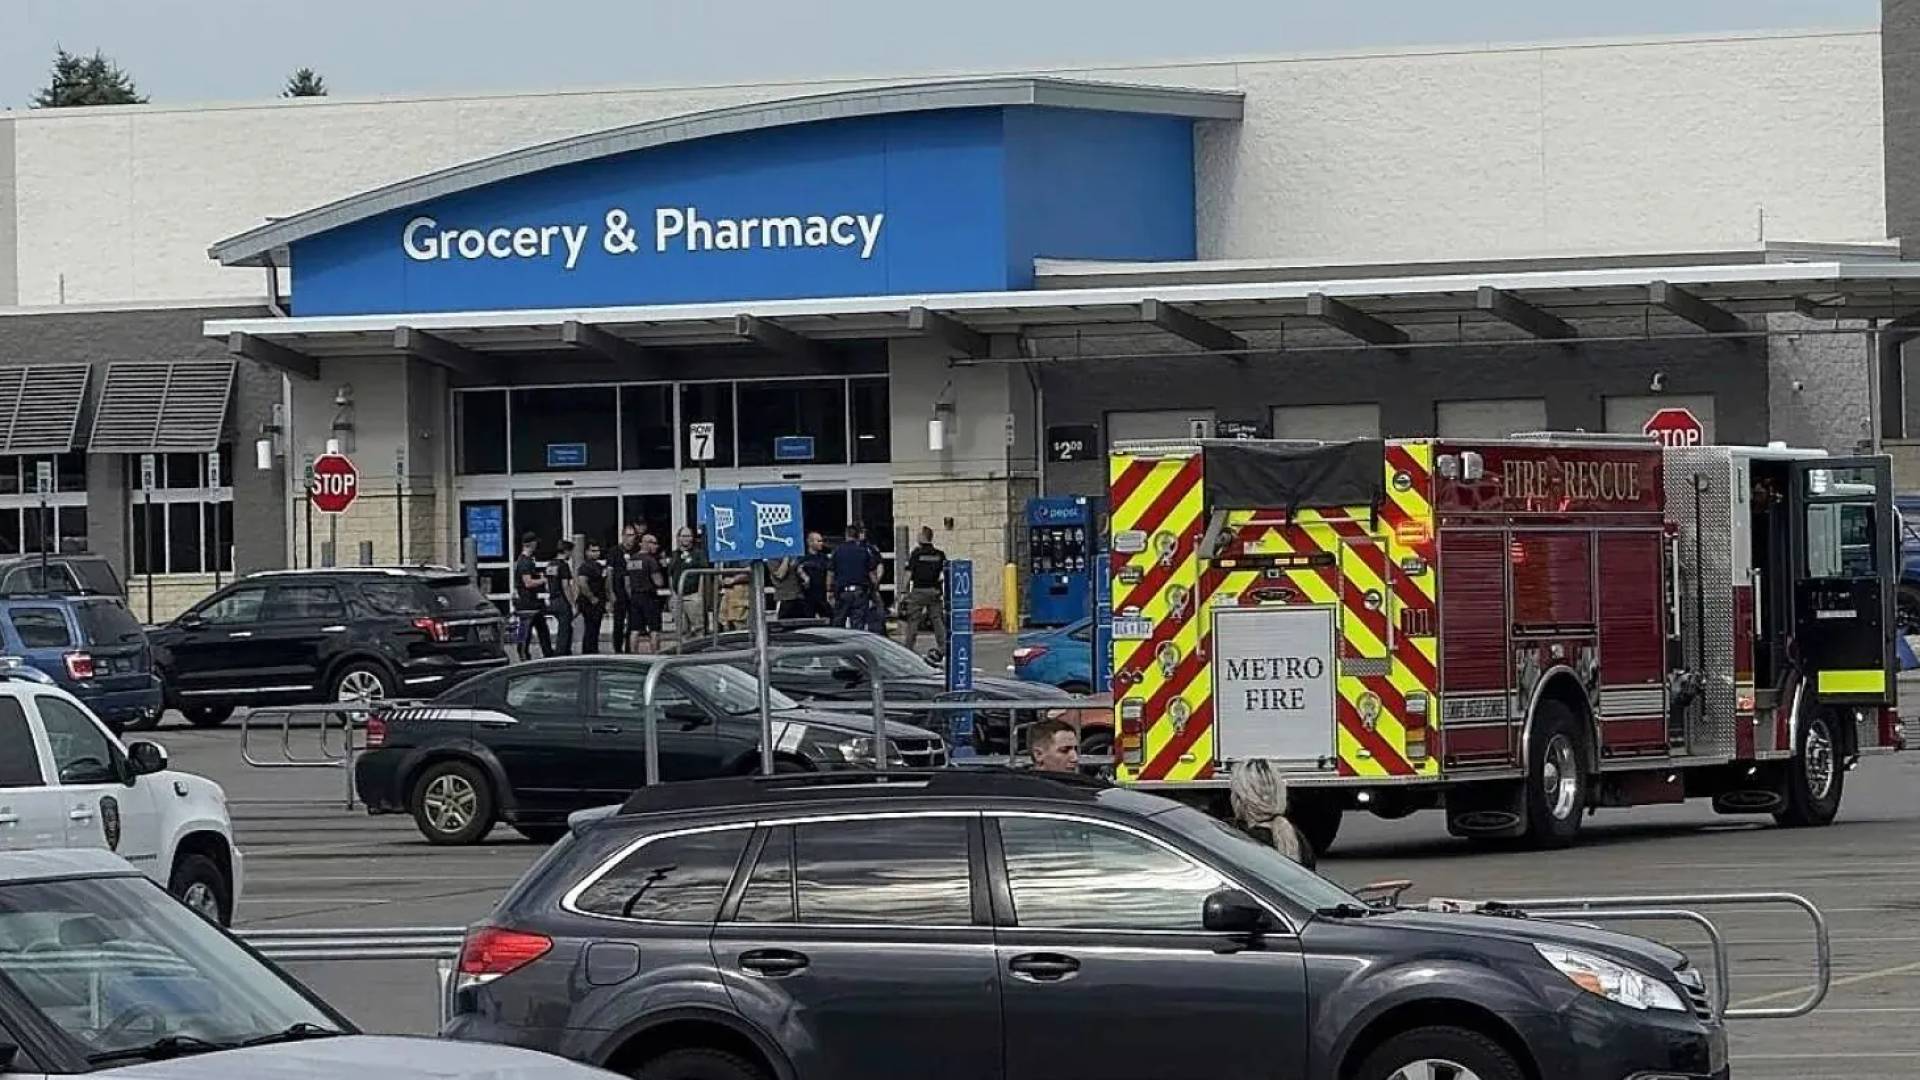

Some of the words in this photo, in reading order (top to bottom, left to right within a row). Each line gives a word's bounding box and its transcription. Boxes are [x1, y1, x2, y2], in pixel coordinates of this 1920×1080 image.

[403, 216, 588, 269] Grocery
[603, 208, 639, 255] &
[655, 207, 884, 259] Pharmacy
[690, 424, 712, 434] ROW
[695, 434, 708, 457] 7
[311, 473, 355, 495] STOP
[1503, 461, 1549, 499] FIRE
[1564, 461, 1640, 500] RESCUE
[954, 571, 970, 595] 20
[1403, 608, 1432, 635] 11
[1226, 656, 1324, 681] METRO
[1244, 687, 1305, 711] FIRE
